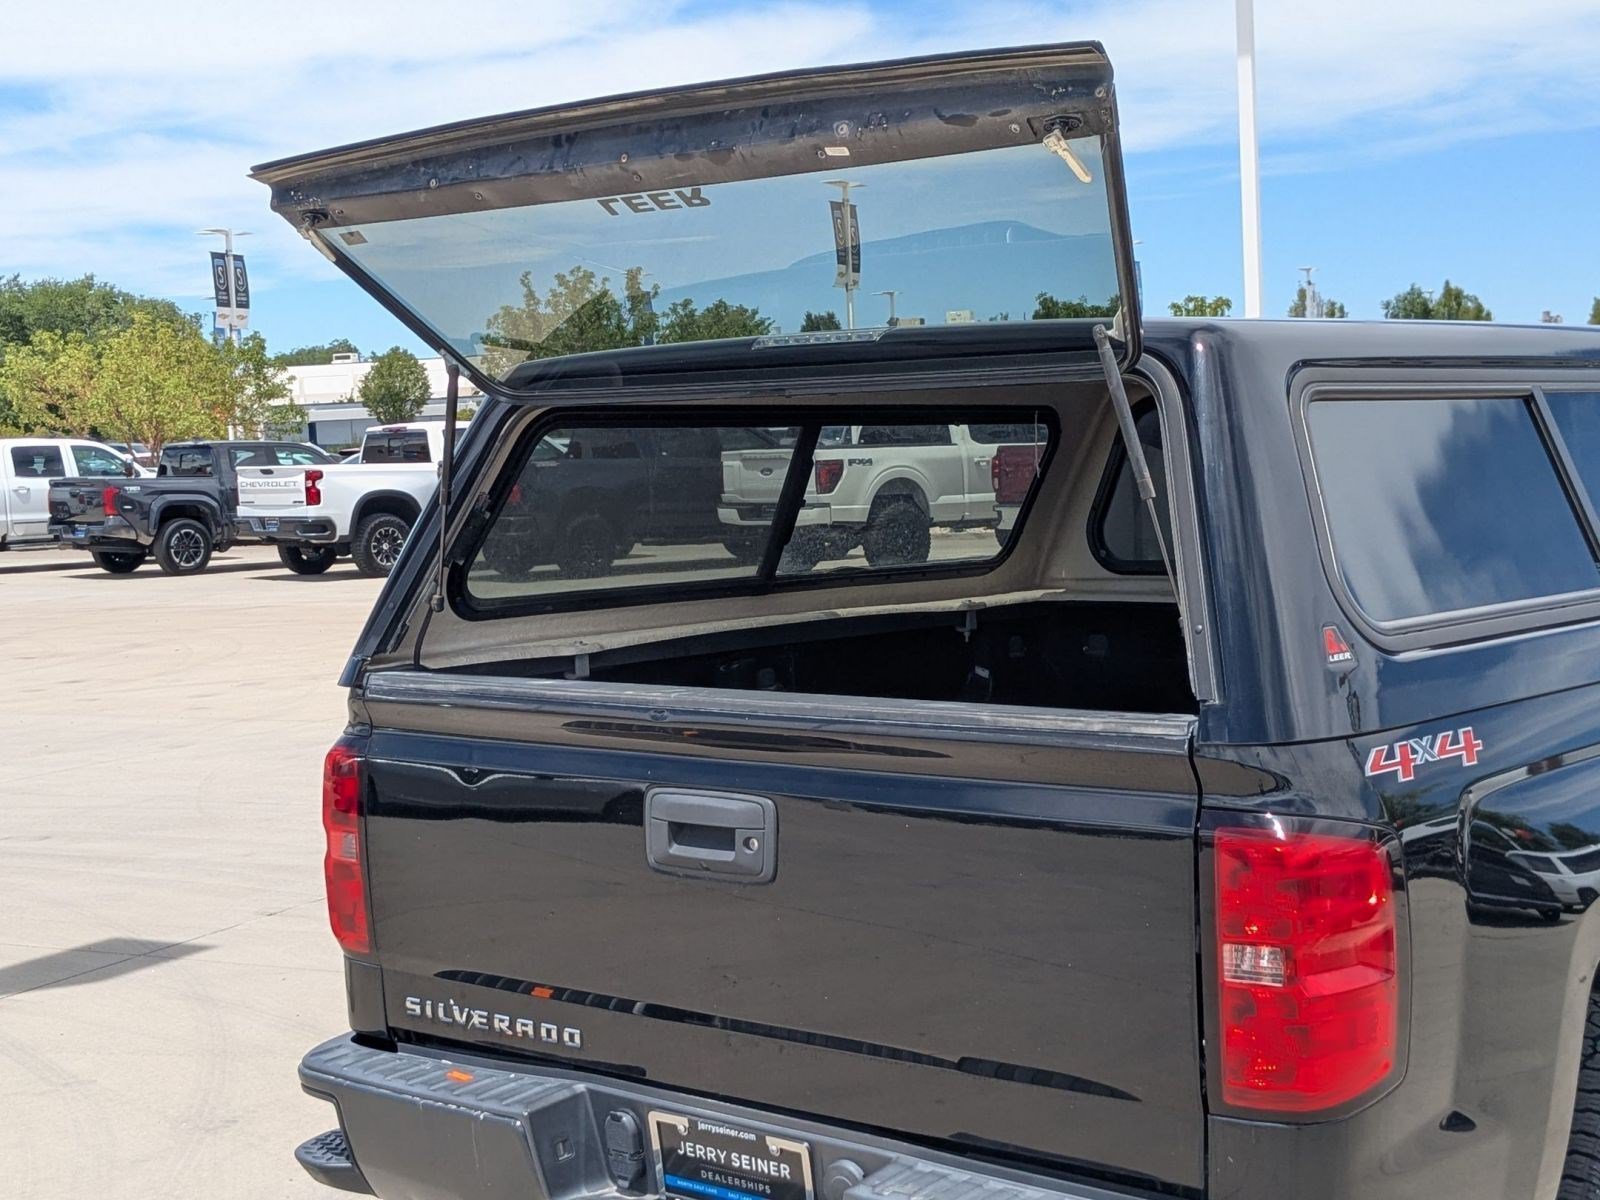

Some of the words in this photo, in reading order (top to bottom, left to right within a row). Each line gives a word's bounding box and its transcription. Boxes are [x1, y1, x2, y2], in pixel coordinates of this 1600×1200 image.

[848, 458, 872, 466] FX4
[1329, 652, 1352, 662] LEER
[405, 996, 581, 1048] SILVERADO
[698, 1121, 757, 1141] jerryseiner.com
[677, 1141, 727, 1163] JERRY
[730, 1152, 791, 1180] SEINER
[701, 1169, 771, 1194] DEALERSHIPS
